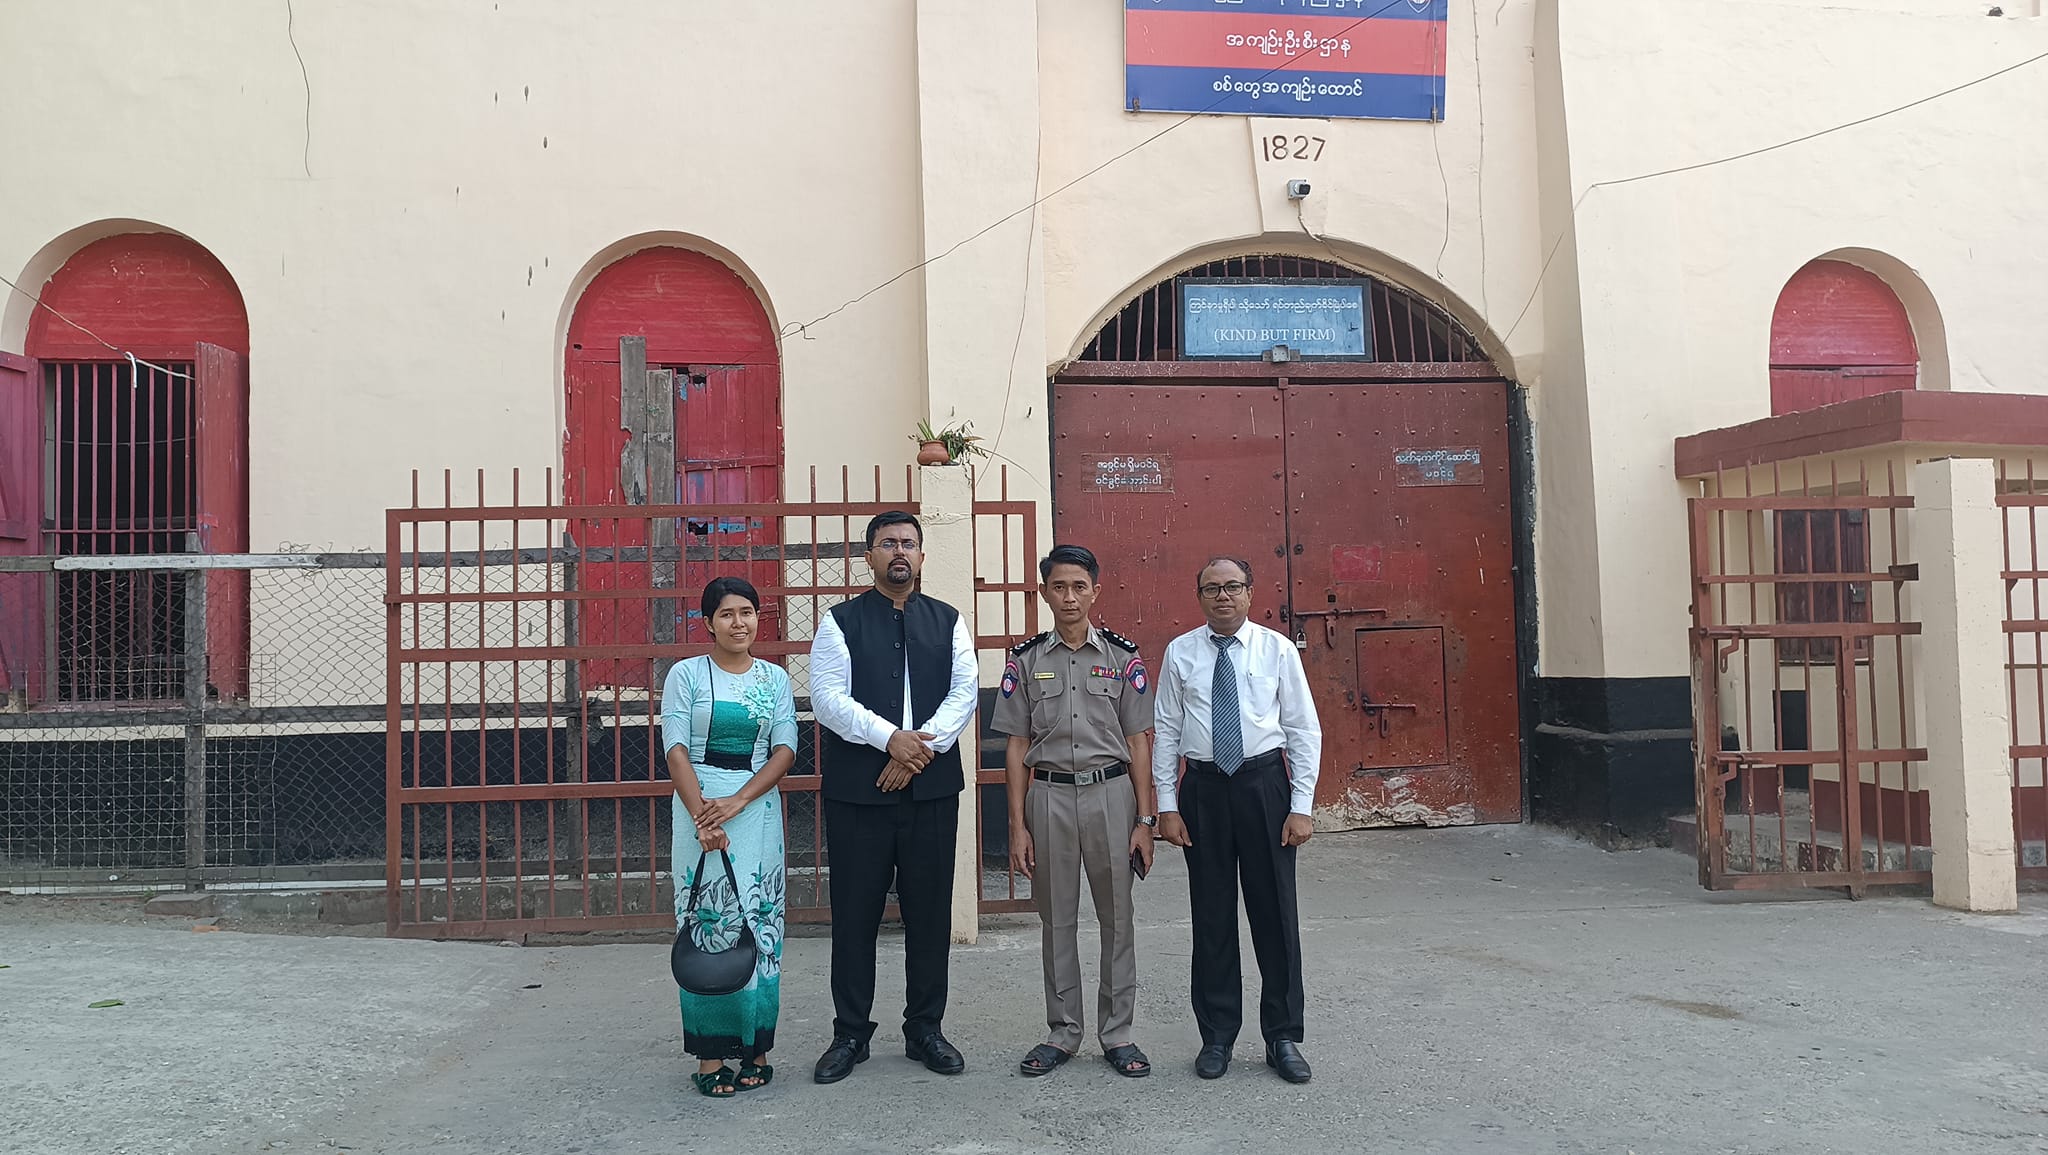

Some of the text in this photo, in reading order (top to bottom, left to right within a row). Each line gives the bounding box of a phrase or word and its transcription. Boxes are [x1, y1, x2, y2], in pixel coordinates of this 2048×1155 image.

[1262, 135, 1327, 162] 1827
[1213, 328, 1336, 343] (KIND BUT FIRM)
